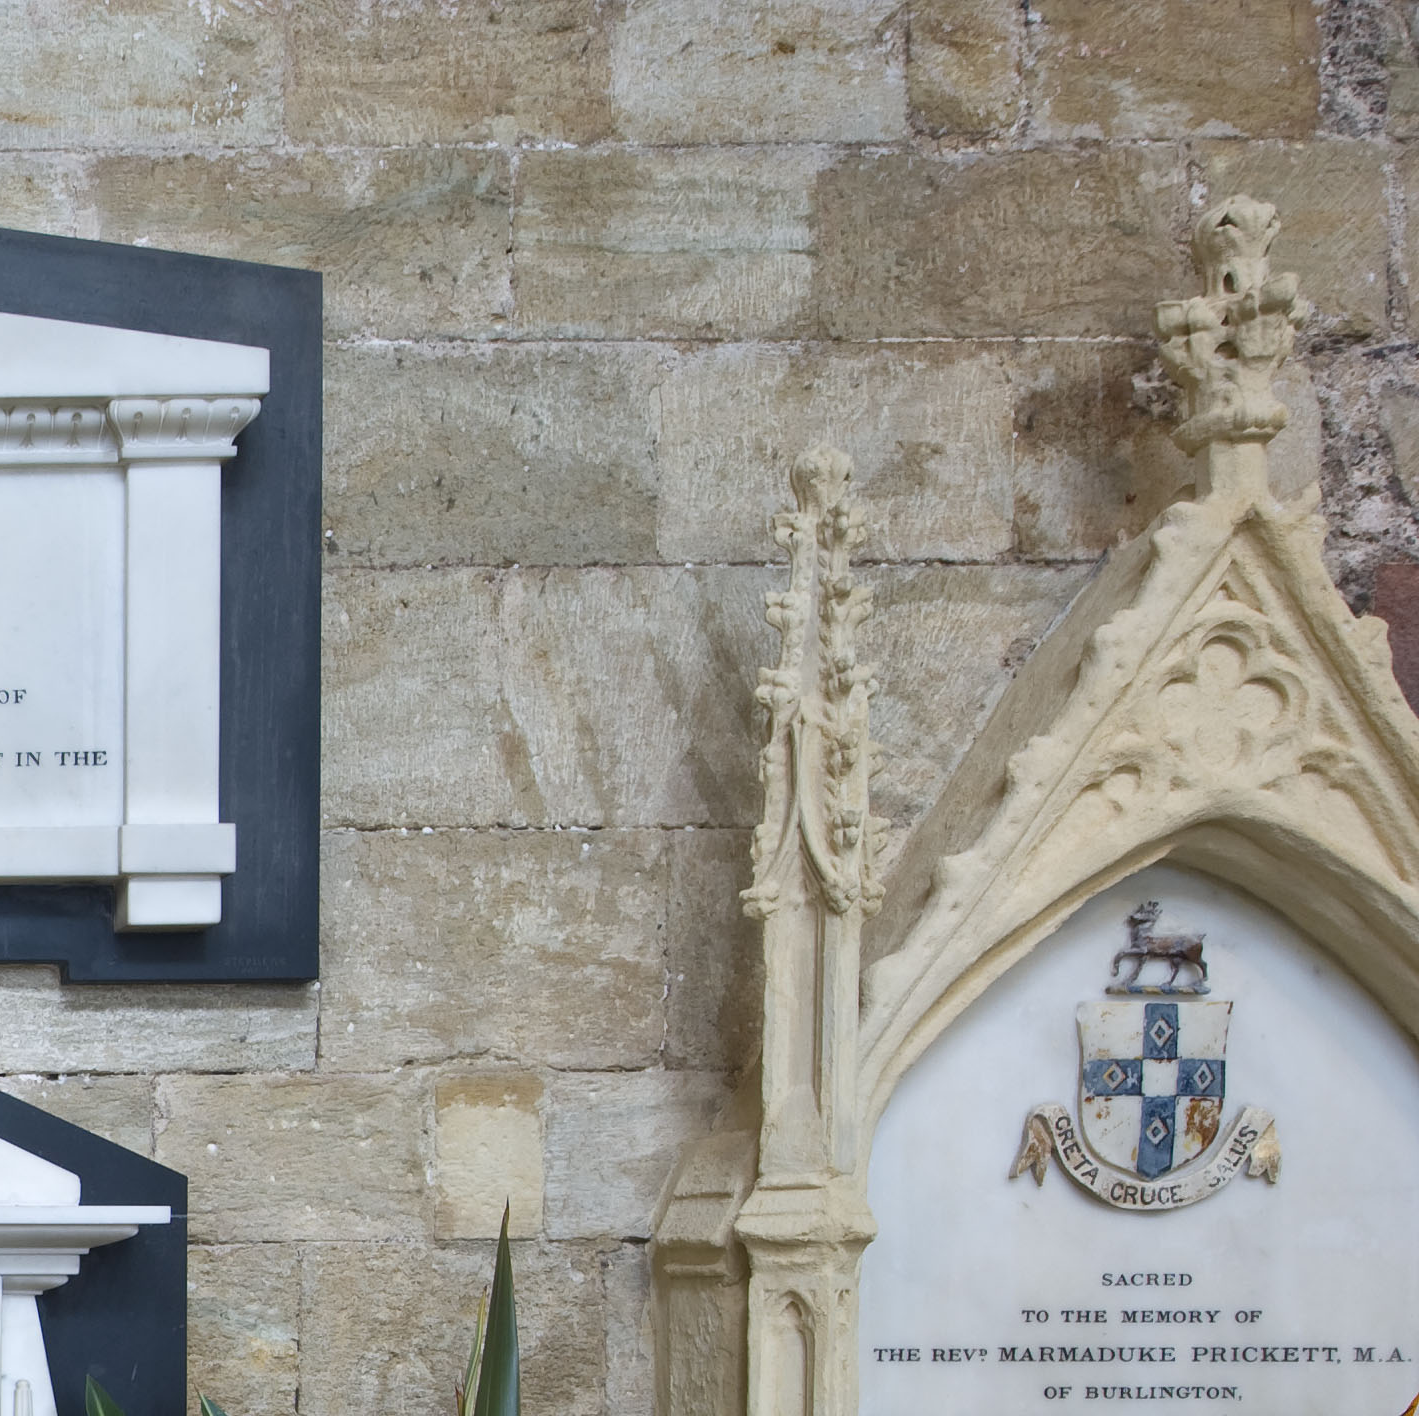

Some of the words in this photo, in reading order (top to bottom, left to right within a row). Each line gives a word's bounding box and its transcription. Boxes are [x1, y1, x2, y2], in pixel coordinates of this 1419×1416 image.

[1110, 1183, 1184, 1206] CRUCE
[1102, 1273, 1192, 1286] SACRED
[1022, 1310, 1049, 1323] TO
[1061, 1310, 1107, 1323] THE
[1121, 1310, 1221, 1323] MEMORY
[1235, 1310, 1262, 1323] OF
[874, 1348, 921, 1362] THE
[998, 1347, 1175, 1362] MARMADUKE
[1192, 1347, 1341, 1364] PRICKETT,
[1044, 1386, 1072, 1399] OF
[1085, 1386, 1242, 1401] BURLINGTON,
